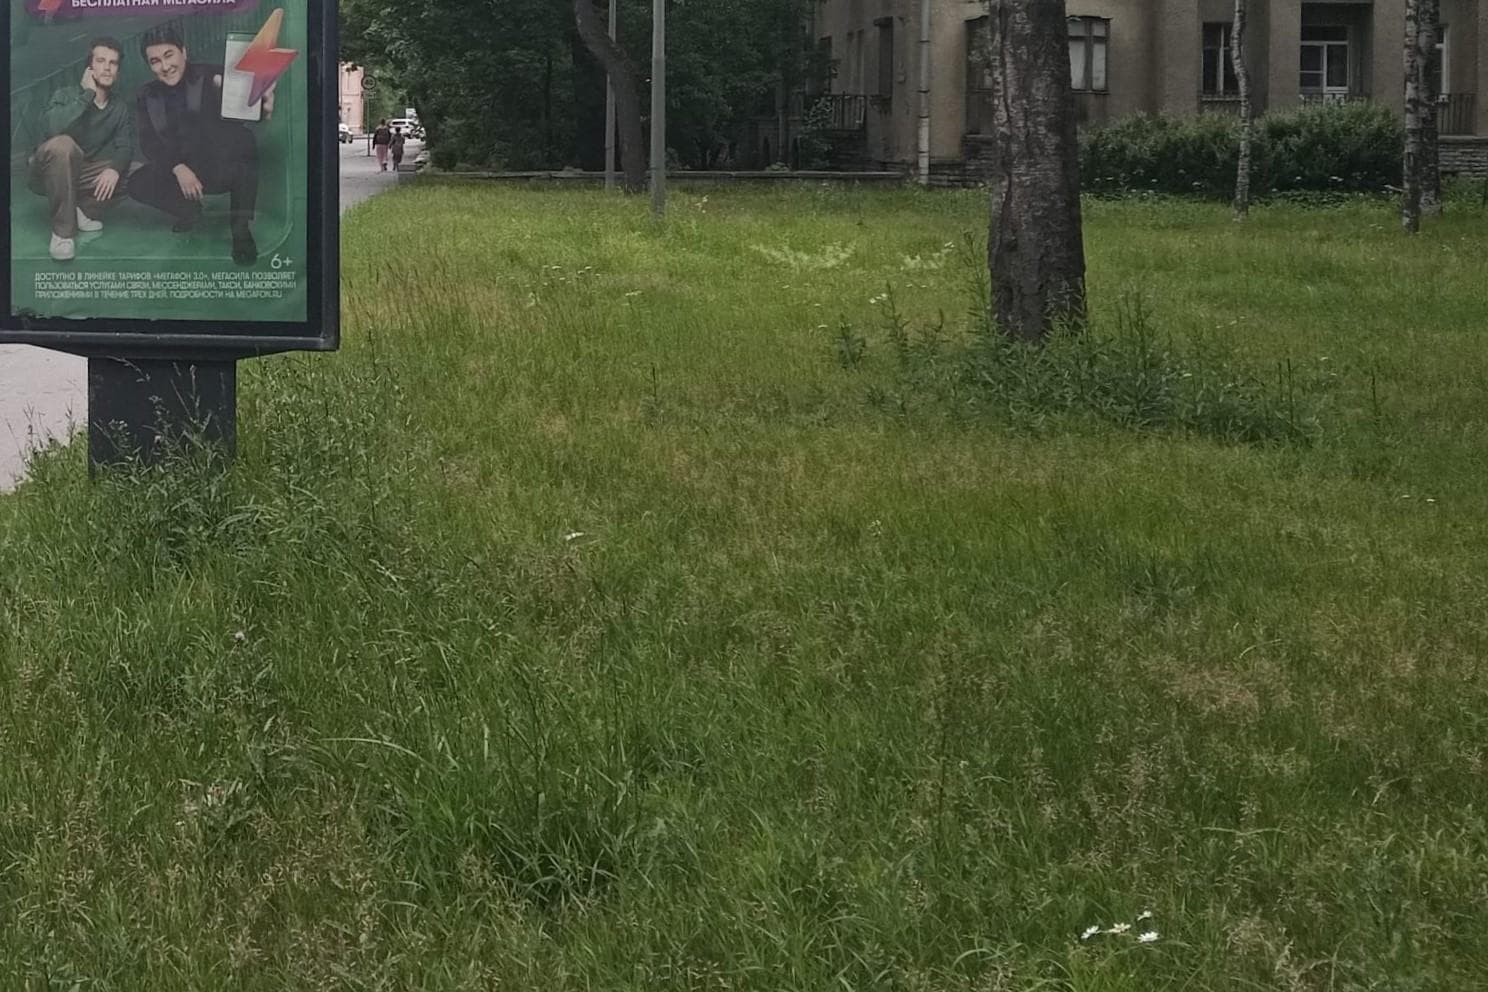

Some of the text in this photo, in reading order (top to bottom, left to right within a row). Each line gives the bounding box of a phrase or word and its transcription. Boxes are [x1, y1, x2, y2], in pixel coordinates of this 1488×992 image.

[270, 253, 293, 269] 6+
[34, 272, 76, 281] ДОСТУПНО
[211, 272, 250, 281] МЕГАСИЛА
[251, 272, 296, 281] ПОЗВОЛЯЕТ
